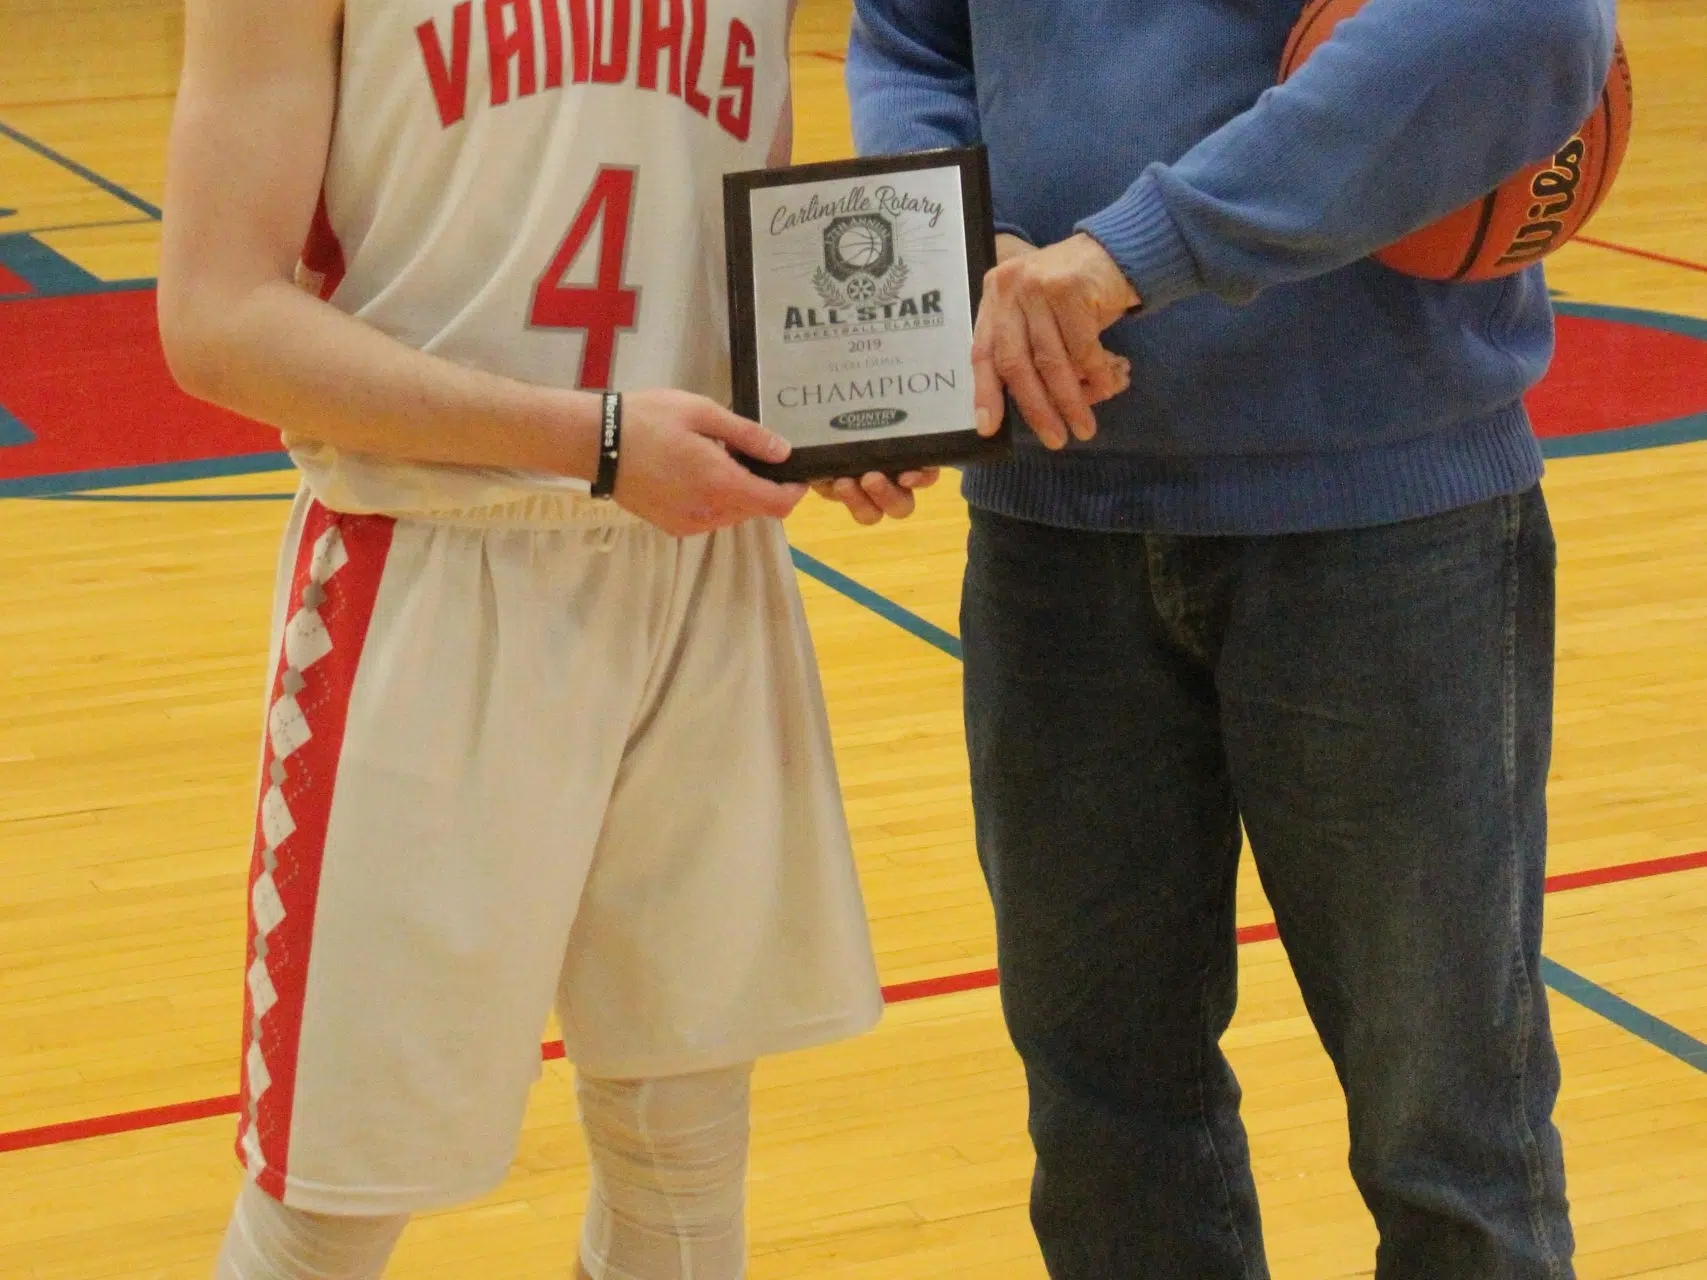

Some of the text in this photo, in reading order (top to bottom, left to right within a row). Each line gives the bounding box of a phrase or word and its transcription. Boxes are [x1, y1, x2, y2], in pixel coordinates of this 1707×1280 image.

[770, 185, 944, 236] Carlinville Rotary
[524, 163, 642, 392] 4
[784, 289, 943, 329] ALL STAR
[848, 338, 882, 354] 2019
[777, 369, 957, 408] CHAMPION
[604, 394, 618, 447] Worries
[839, 409, 897, 424] COUNTRY
